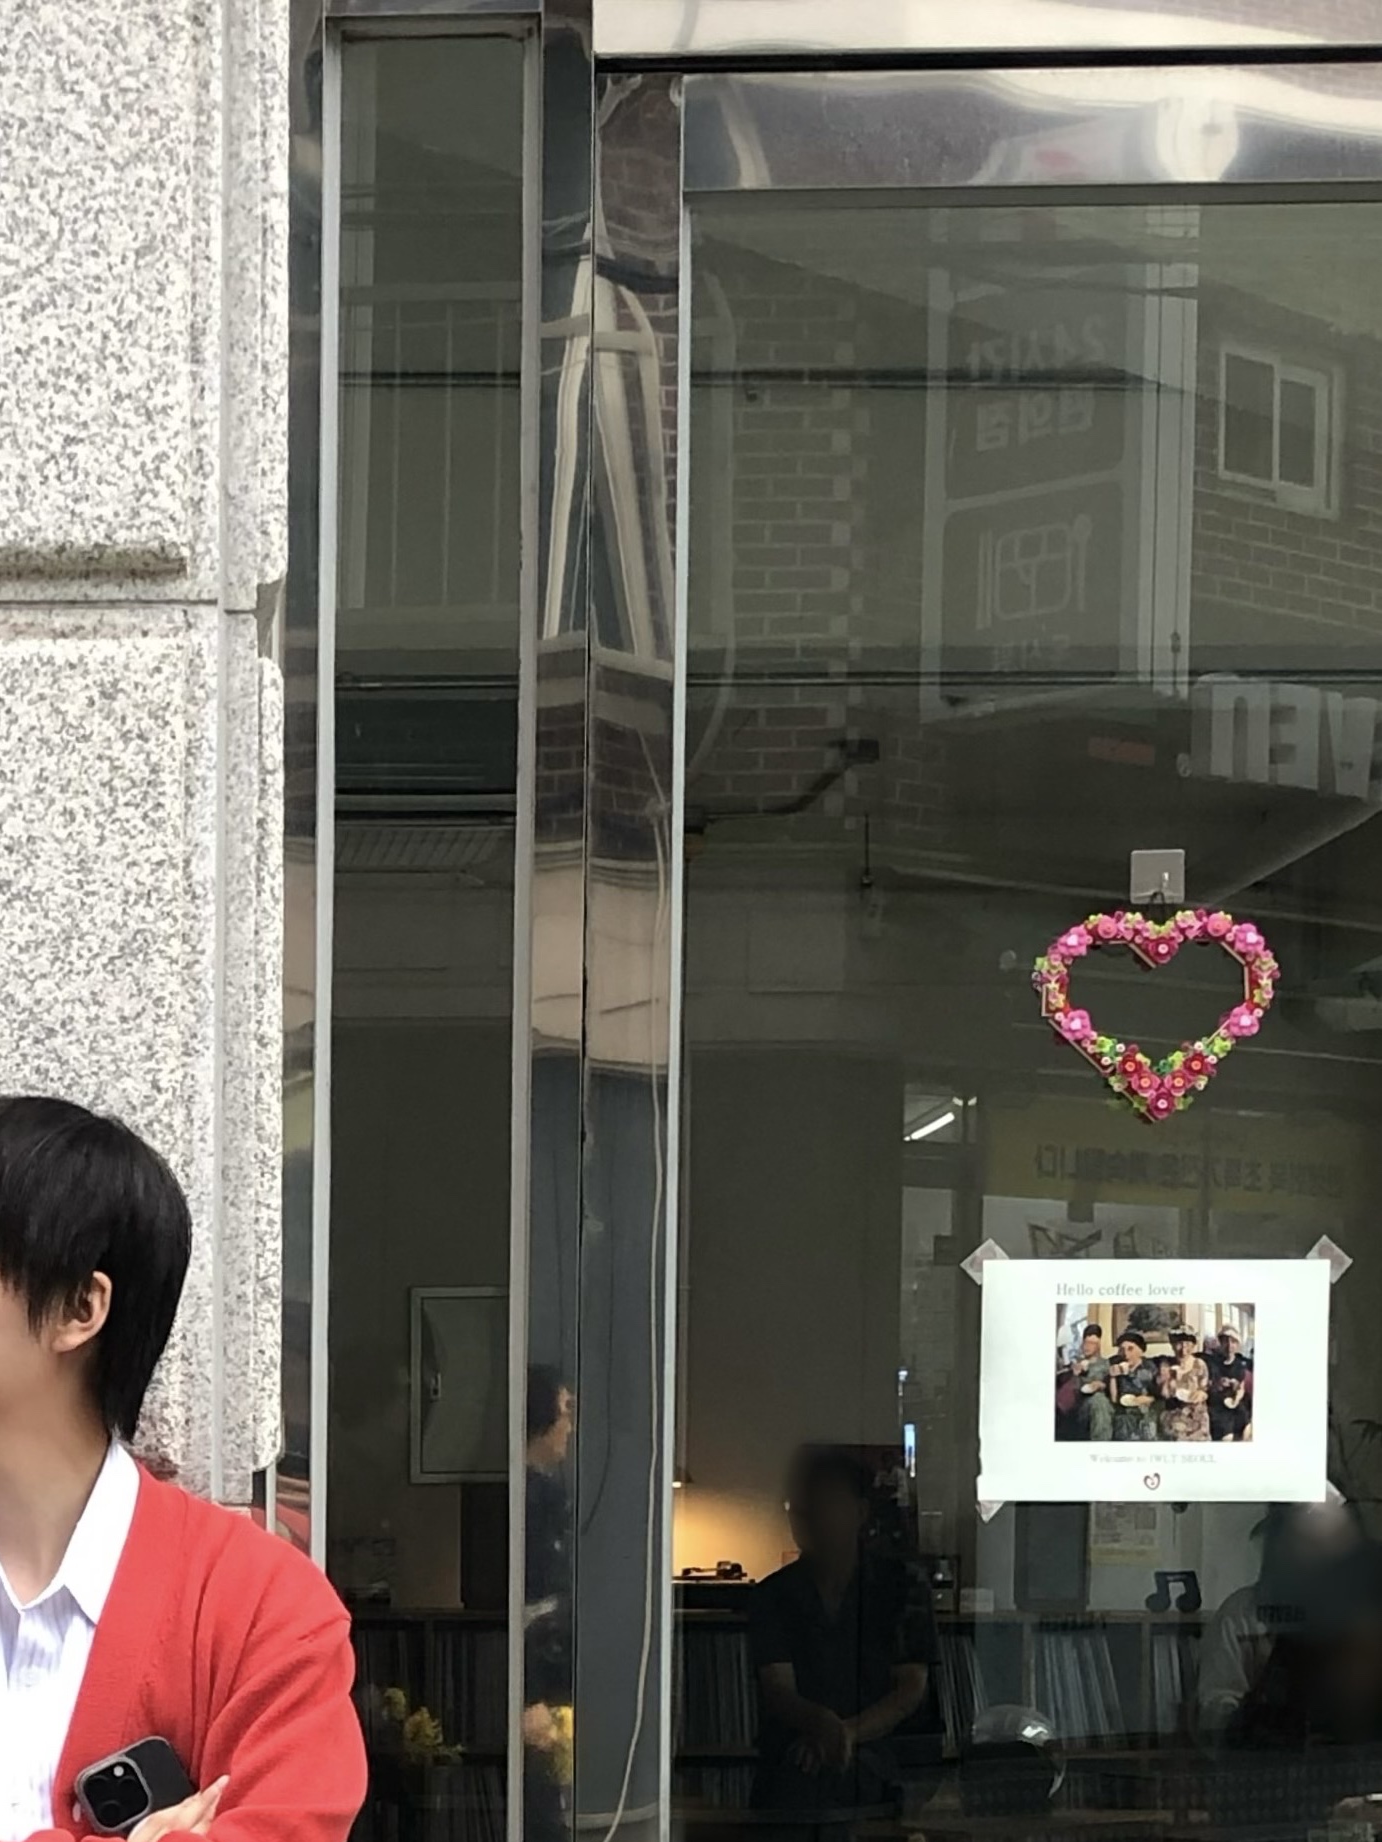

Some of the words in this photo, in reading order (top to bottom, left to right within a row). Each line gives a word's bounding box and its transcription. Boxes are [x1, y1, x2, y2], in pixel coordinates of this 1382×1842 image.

[1056, 1283, 1093, 1295] Hello
[1098, 1283, 1143, 1296] coffee
[1148, 1283, 1185, 1295] lover
